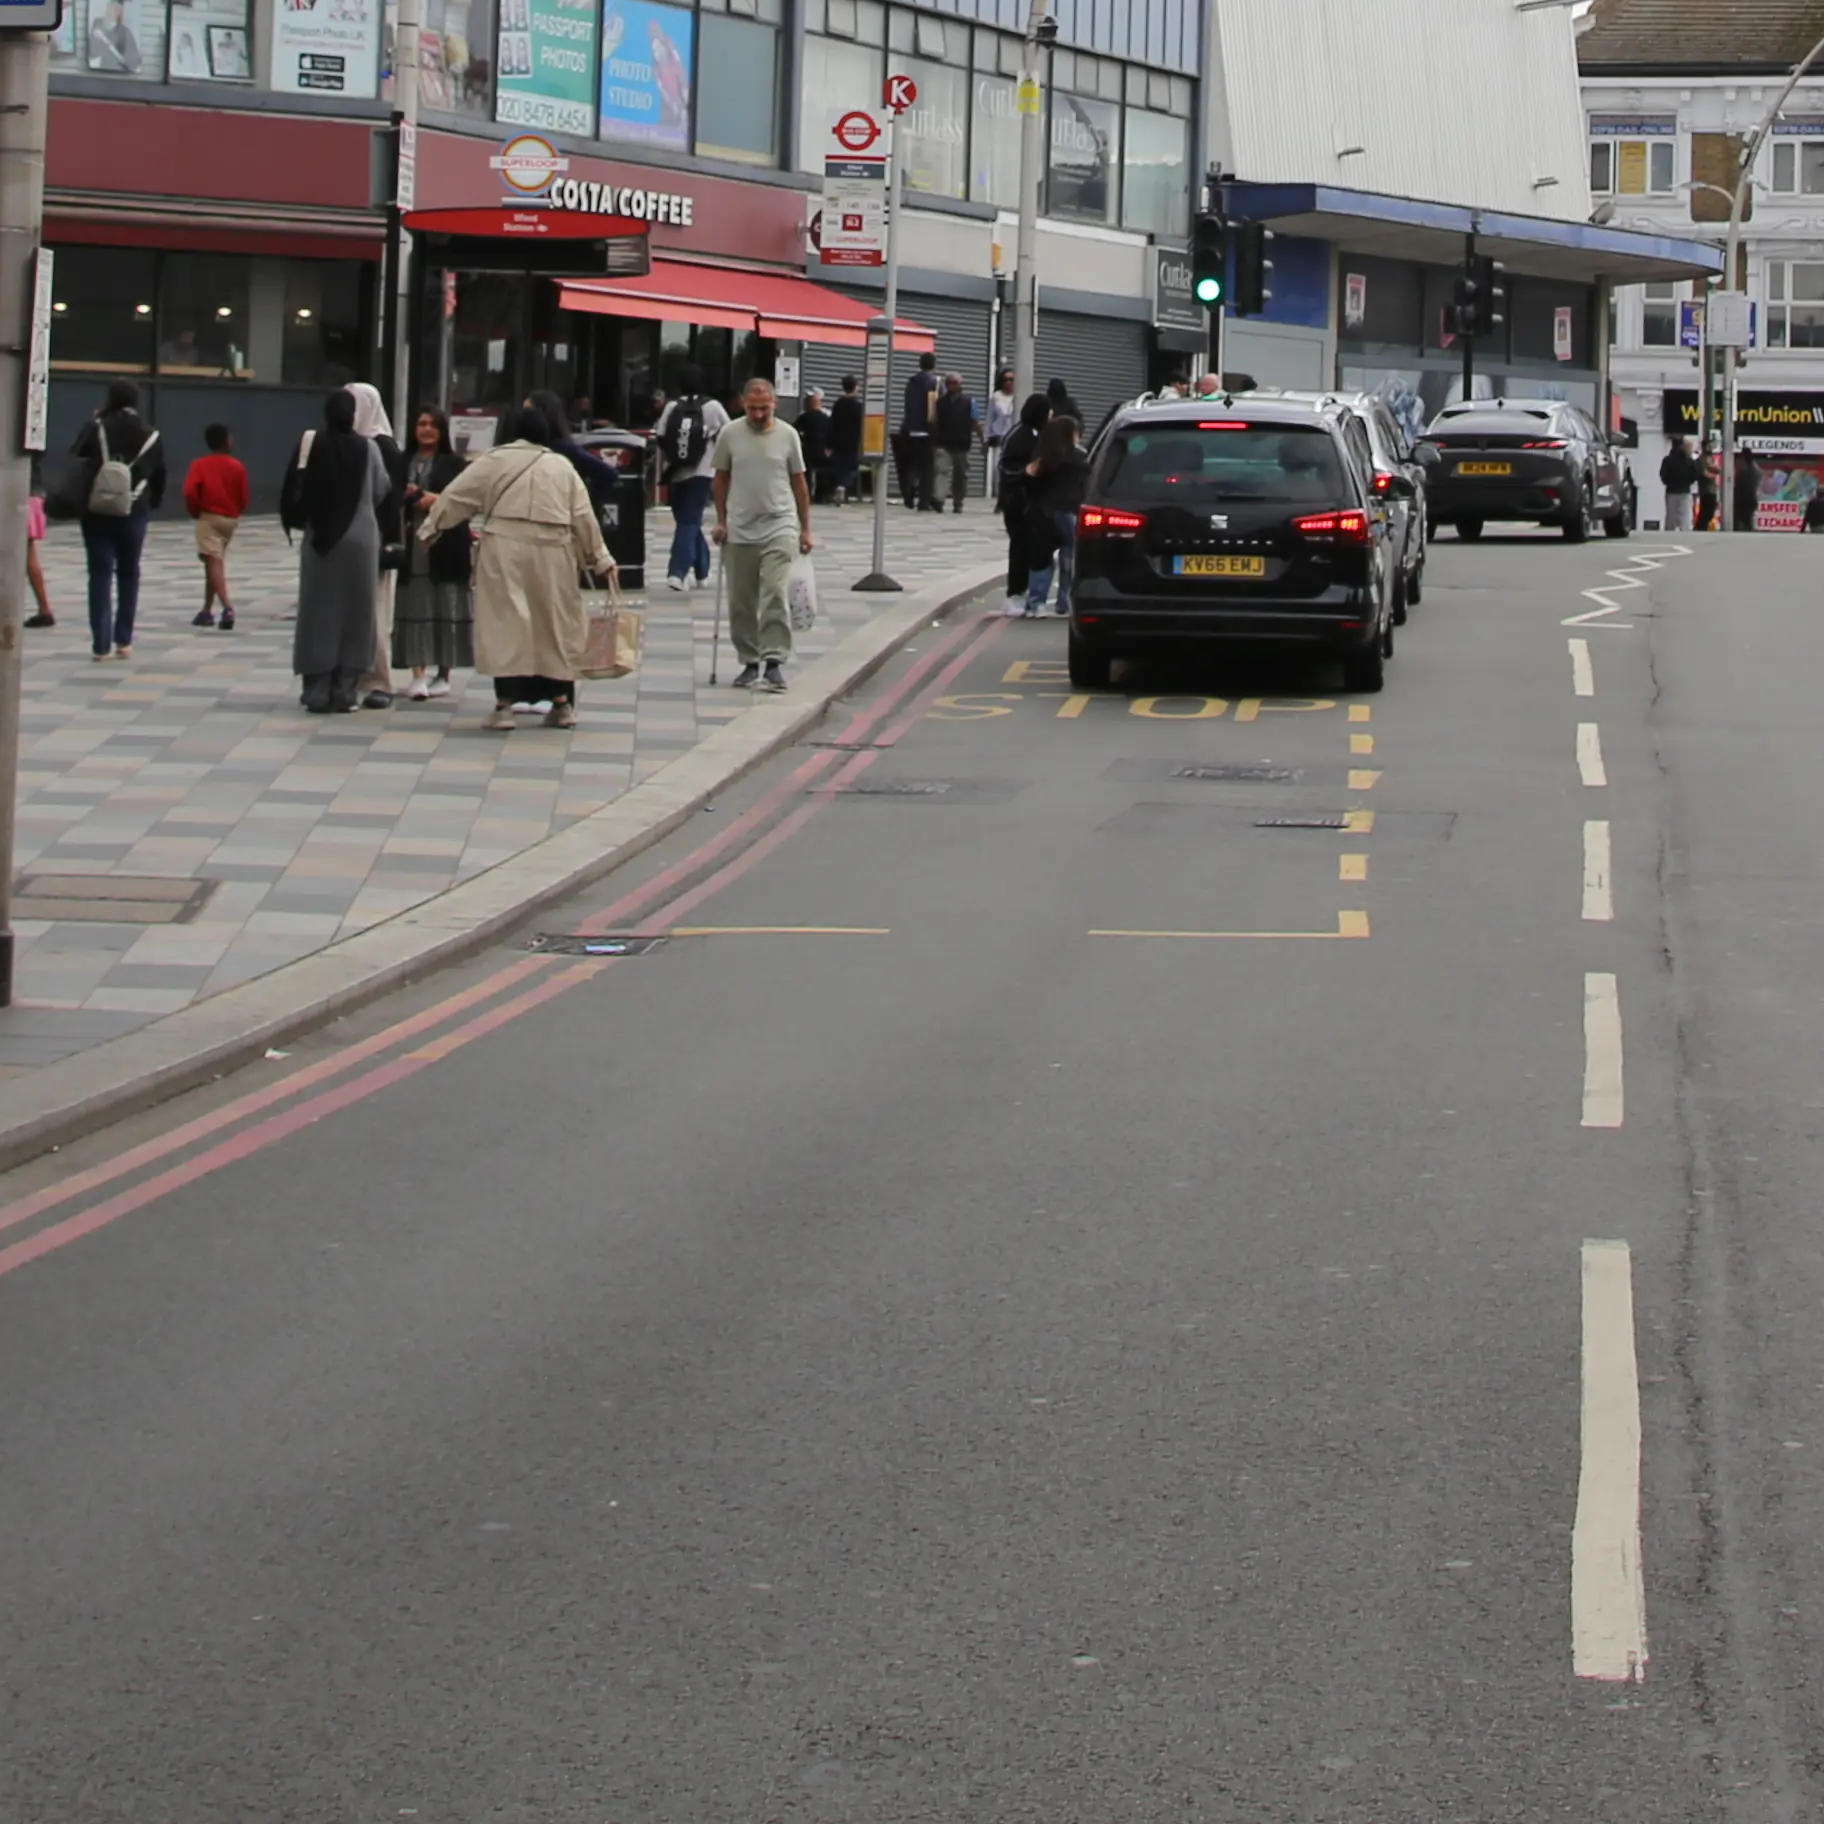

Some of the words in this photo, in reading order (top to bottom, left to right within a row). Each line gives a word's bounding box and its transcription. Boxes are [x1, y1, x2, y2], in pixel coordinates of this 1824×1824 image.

[533, 13, 594, 41] PASSPORT
[540, 46, 587, 73] PHOTOS
[610, 59, 651, 81] PHOTO
[609, 87, 653, 111] STUDIO
[890, 80, 911, 104] K
[525, 102, 554, 126] 8478
[557, 107, 587, 130] 6454
[500, 158, 559, 168] SUPERLOOP
[550, 177, 614, 213] COSTA
[618, 187, 694, 226] COFFEE
[1681, 405, 1812, 423] WsrnUnion
[1752, 440, 1805, 450] LEGENDS
[1757, 517, 1804, 527] EXCHANG
[1184, 556, 1227, 573] KV66
[1230, 556, 1263, 573] EMJ
[925, 692, 1337, 722] STOP
